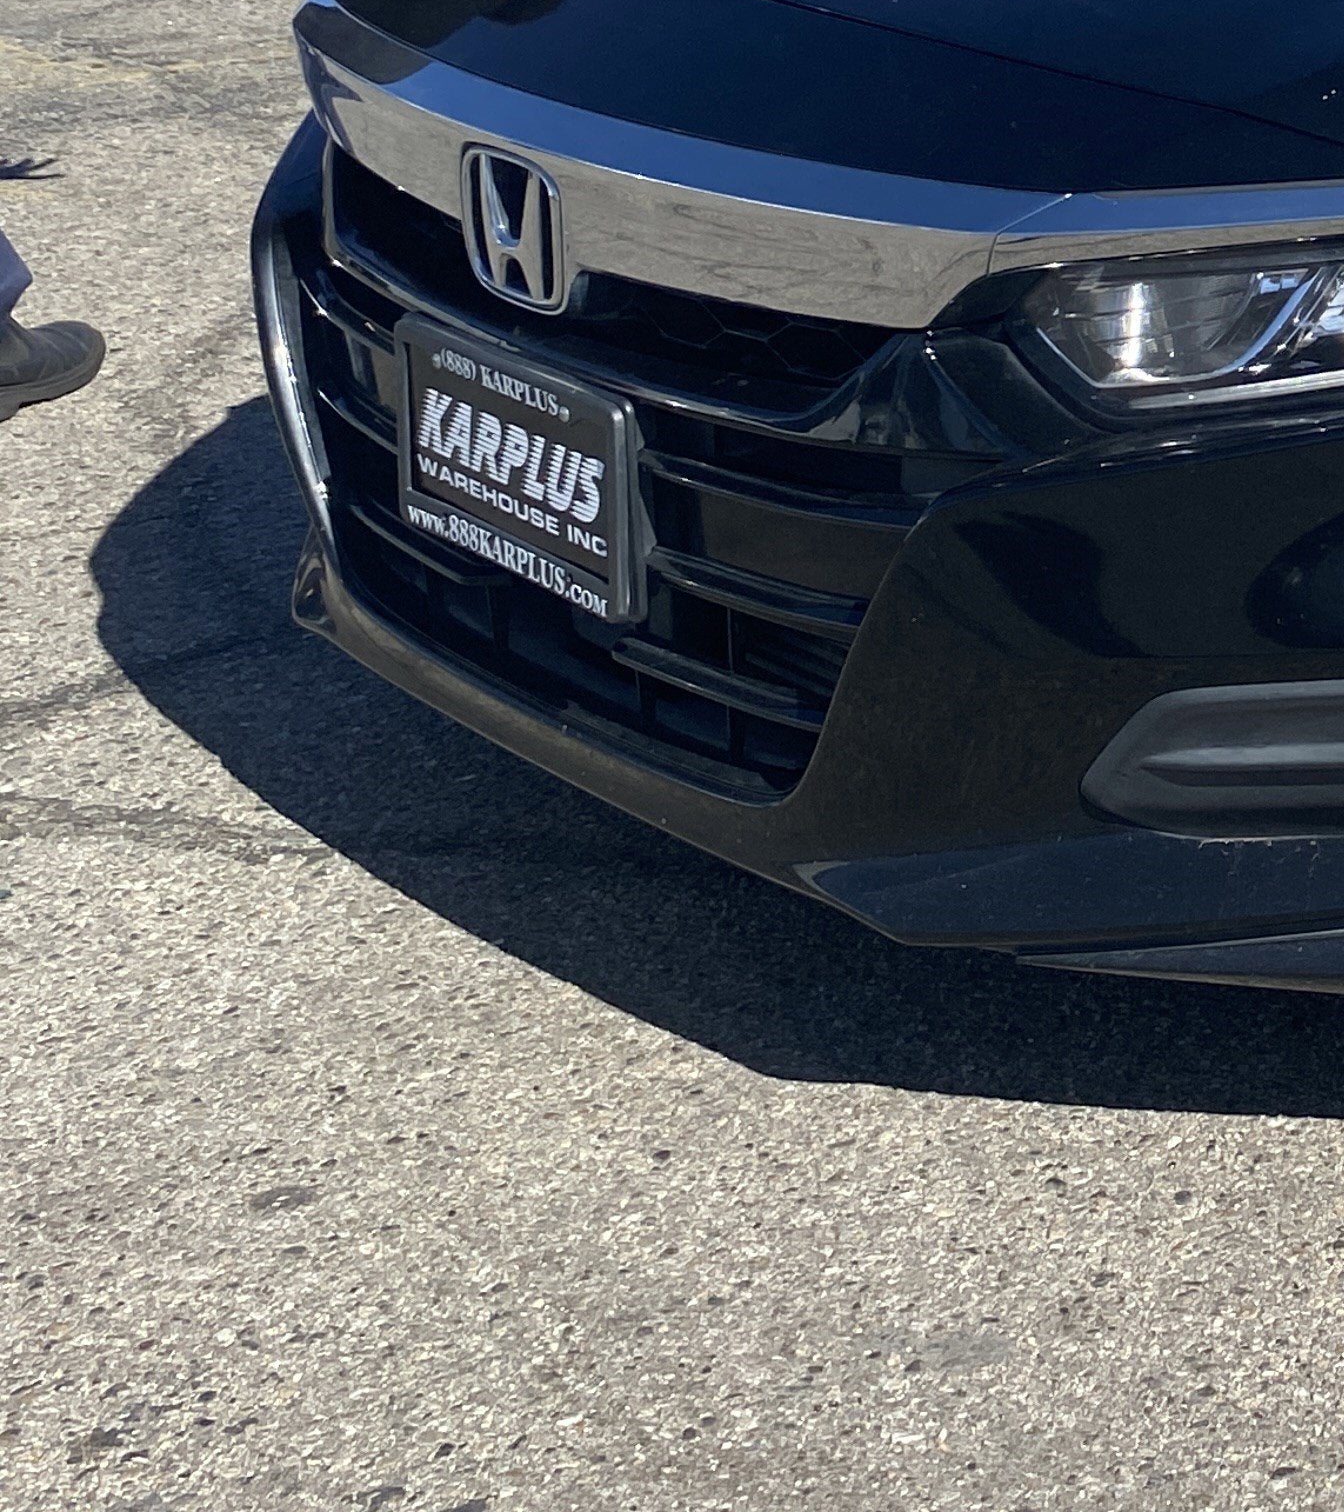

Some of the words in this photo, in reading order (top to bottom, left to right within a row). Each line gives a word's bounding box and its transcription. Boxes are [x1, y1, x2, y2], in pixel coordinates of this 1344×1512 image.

[440, 348, 476, 381] (888)
[480, 365, 559, 416] KARPLUS
[416, 453, 560, 536] WAREHOUSE
[567, 524, 609, 558] INC
[418, 388, 606, 524] KARPLUS
